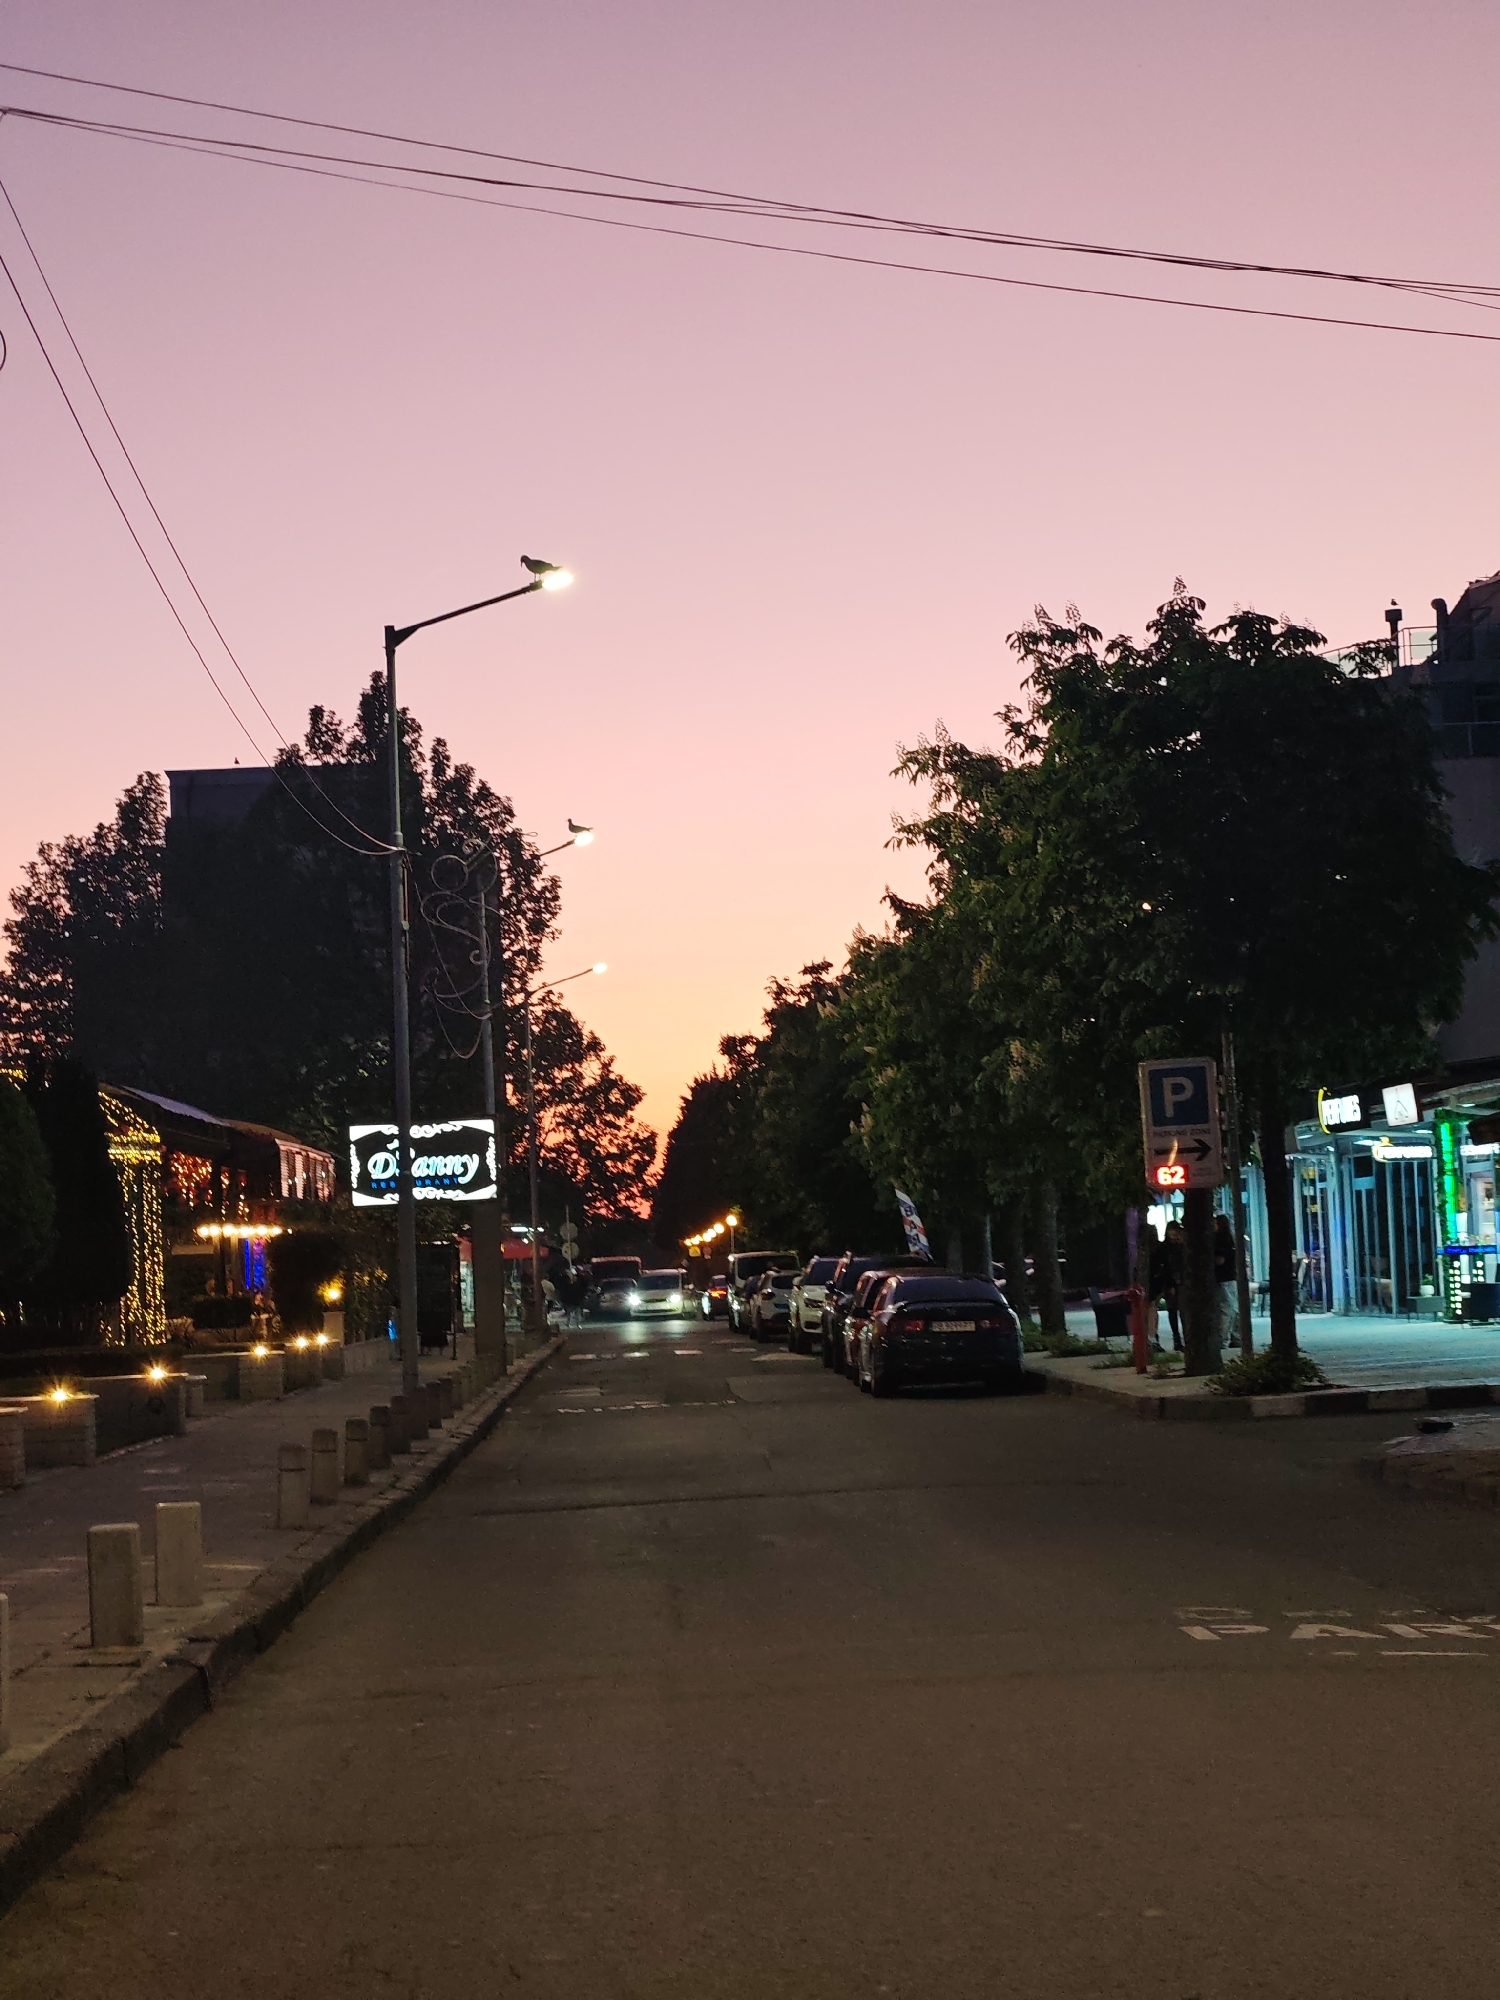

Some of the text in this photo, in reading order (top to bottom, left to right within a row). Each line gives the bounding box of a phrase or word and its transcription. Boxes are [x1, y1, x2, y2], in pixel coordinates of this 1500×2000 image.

[1162, 1076, 1194, 1118] P
[371, 1177, 459, 1189] RESURANT
[1156, 1165, 1186, 1185] 62
